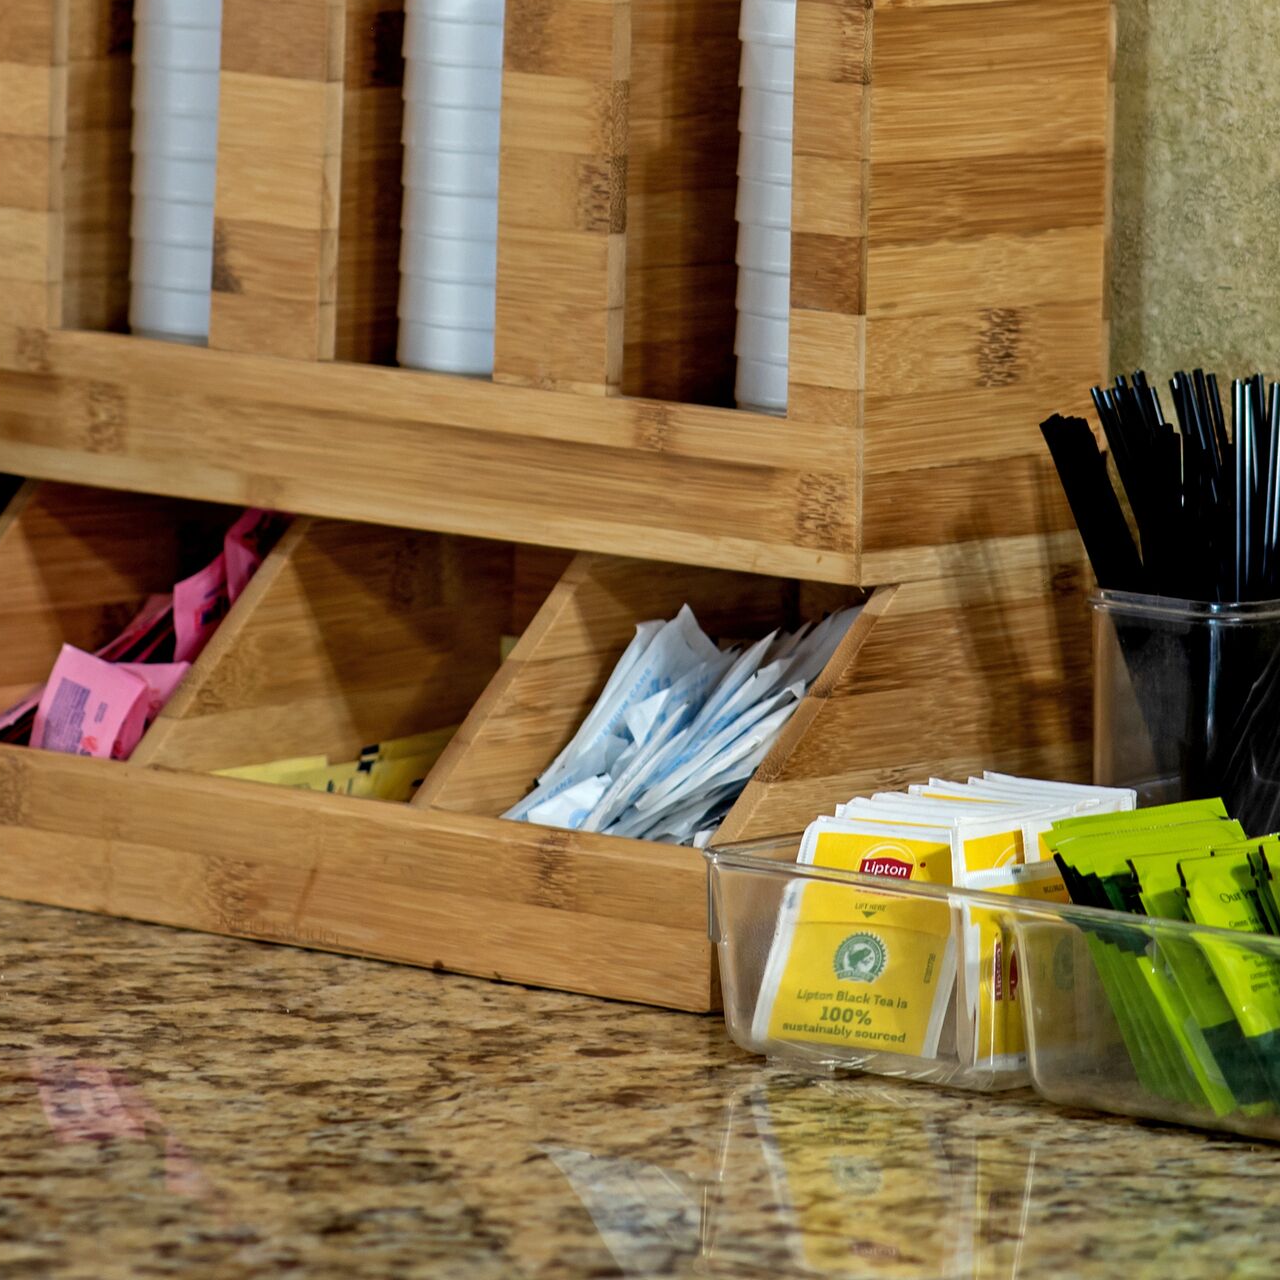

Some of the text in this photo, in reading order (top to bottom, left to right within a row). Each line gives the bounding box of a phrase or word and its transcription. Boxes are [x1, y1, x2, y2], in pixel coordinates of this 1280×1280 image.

[864, 861, 907, 877] Lipton
[855, 902, 868, 911] LIFT
[797, 989, 908, 1009] Lipton Black Tea is
[820, 1006, 872, 1026] 100%
[783, 1022, 907, 1043] sustainably sourced
